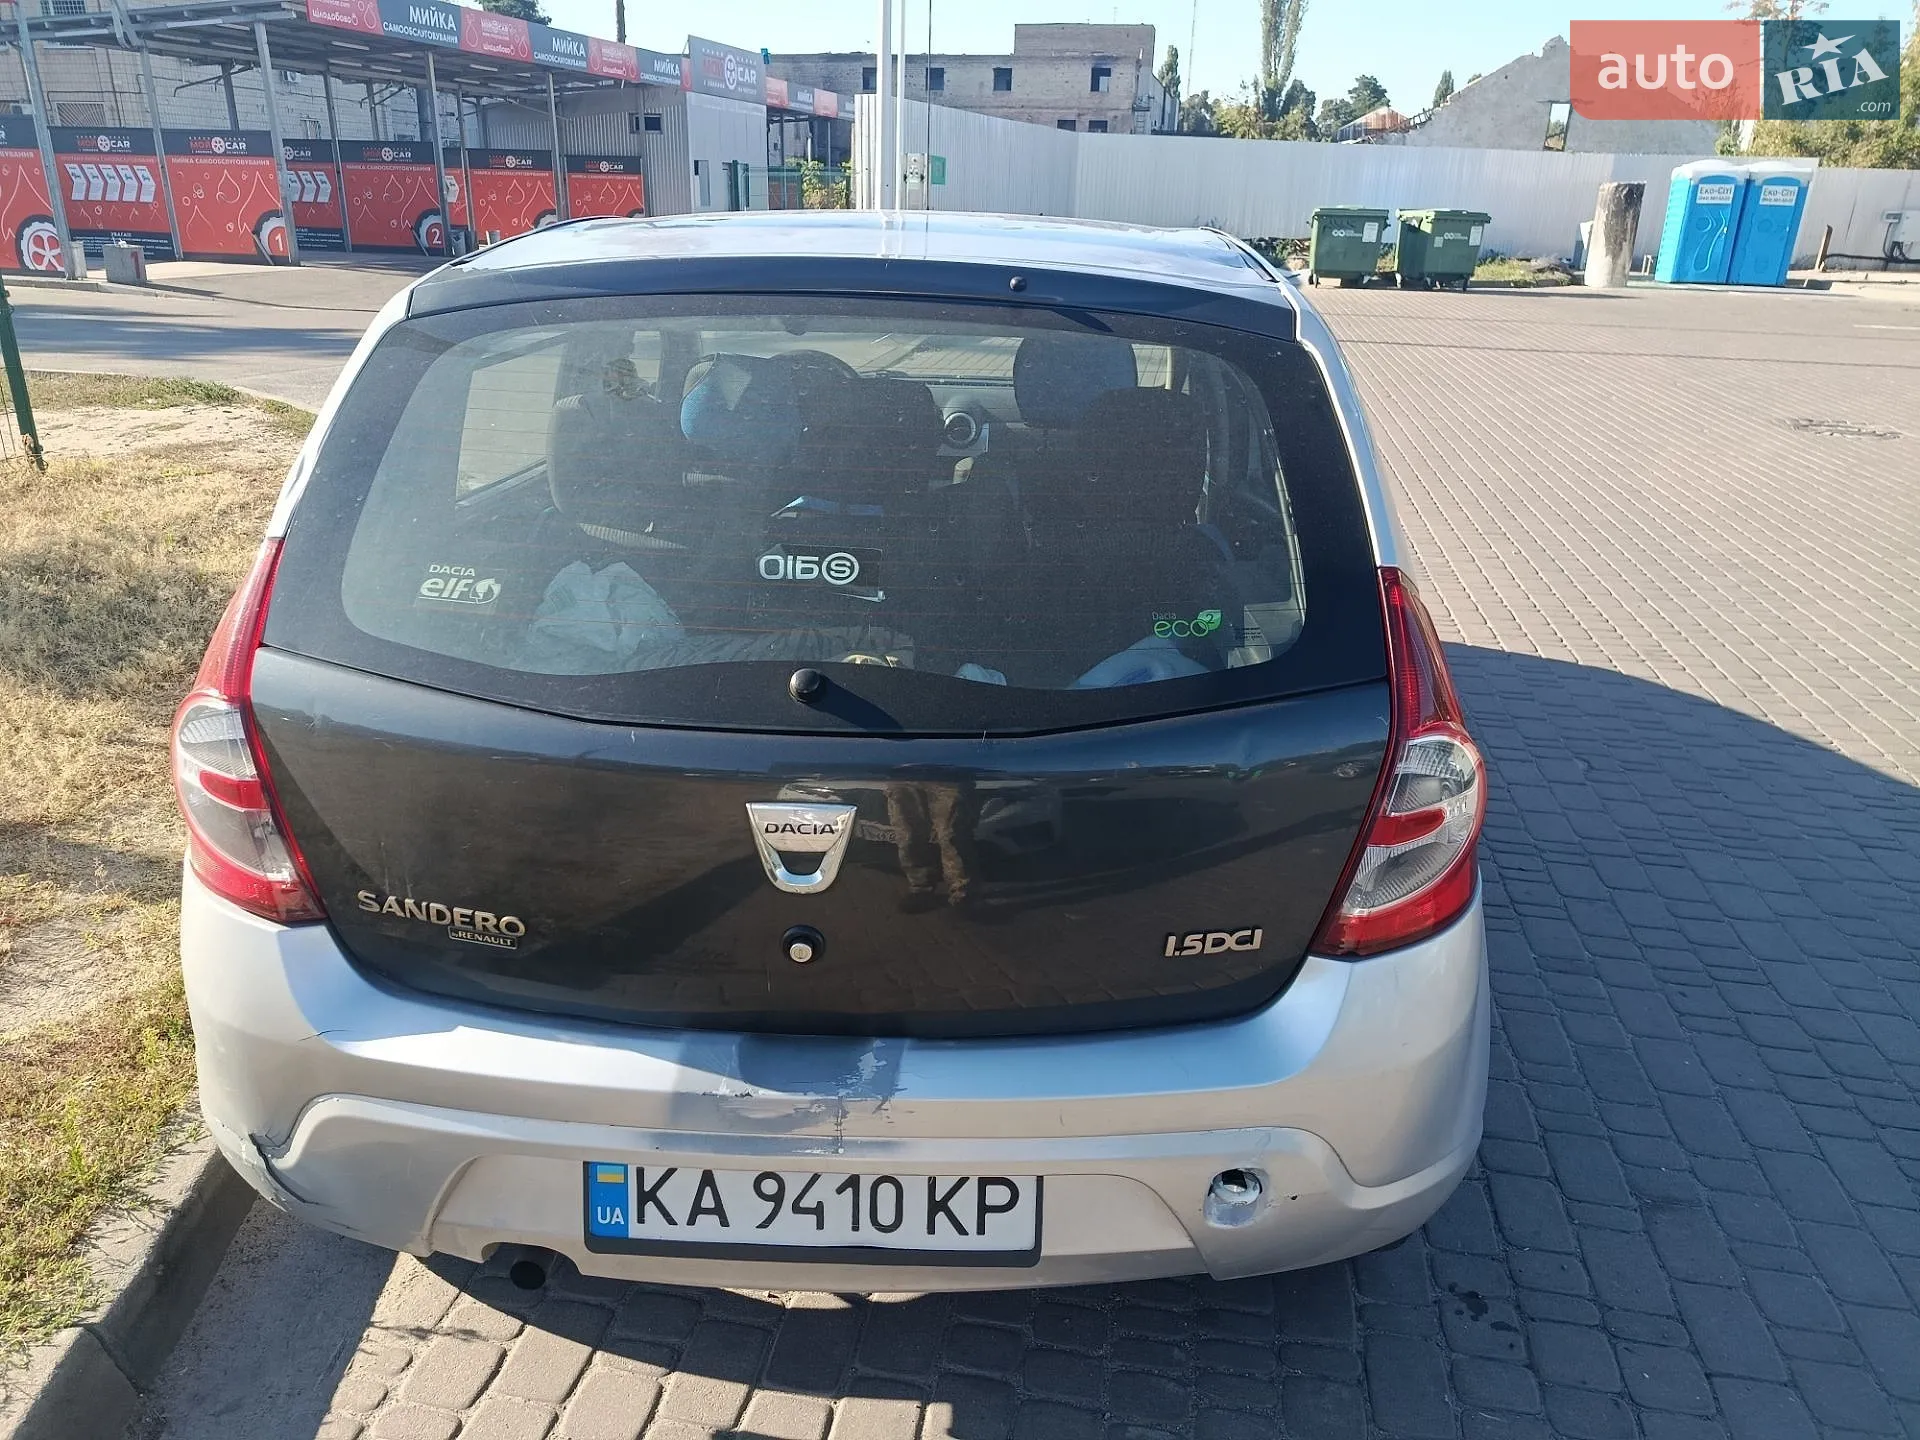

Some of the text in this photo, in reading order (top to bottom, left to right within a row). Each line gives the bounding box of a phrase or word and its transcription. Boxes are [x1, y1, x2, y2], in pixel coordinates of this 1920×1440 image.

[409, 5, 457, 31] МИЙКА
[552, 36, 586, 57] МИЙКА
[653, 58, 680, 76] МИЙКА
[737, 65, 757, 84] CAR
[110, 140, 131, 148] CAR
[225, 142, 247, 150] CAR
[393, 151, 412, 159] CAR
[275, 232, 284, 252] 1
[431, 228, 442, 245] 2
[429, 564, 476, 577] DACIA
[420, 577, 474, 599] elf
[765, 823, 835, 835] DACIA
[357, 889, 526, 937] SANDERO
[458, 930, 513, 947] RENAULT
[636, 1166, 1020, 1236] KA 9410 KP
[597, 1207, 625, 1225] UA
